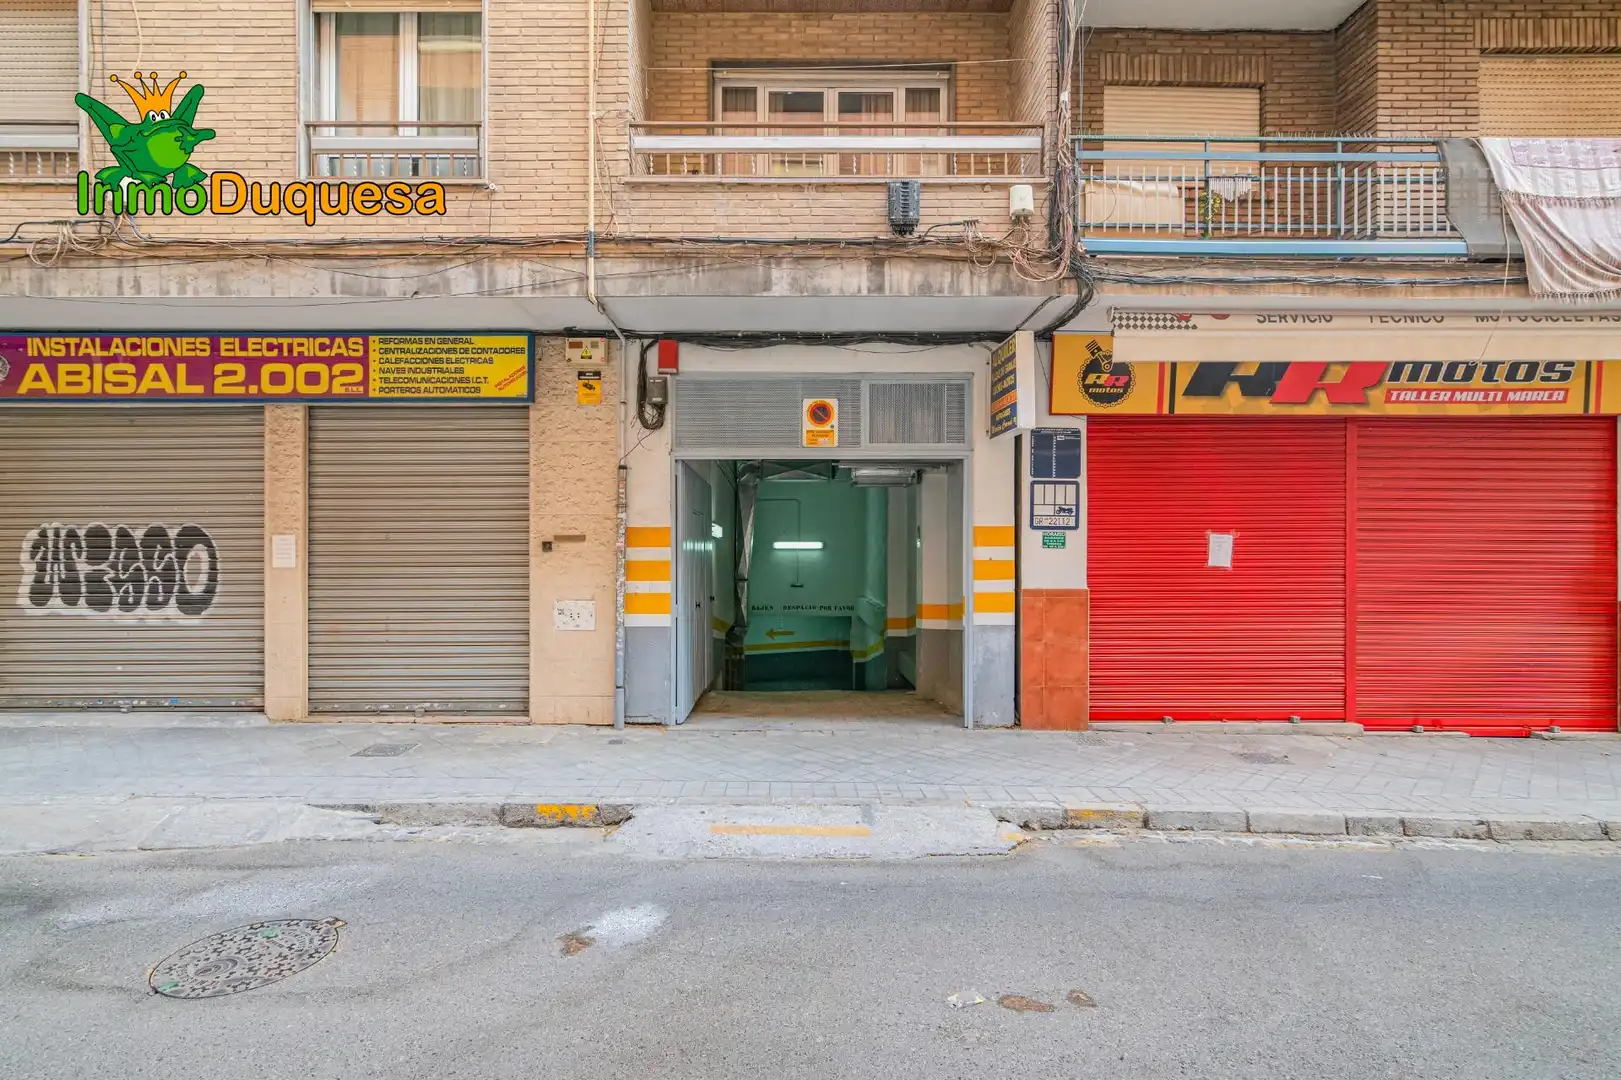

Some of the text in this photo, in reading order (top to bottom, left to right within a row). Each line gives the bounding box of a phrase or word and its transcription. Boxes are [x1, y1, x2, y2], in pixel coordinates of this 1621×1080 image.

[378, 337, 475, 345] REFORMAS EN GENERAL
[27, 337, 364, 357] INSTALACIONES ELECTRICAS
[378, 347, 526, 355] CENTRALIZACIONES DE CONTADORES
[16, 363, 364, 394] ABISAL 2.002
[378, 376, 471, 384] TELECOMUNICACIONES
[378, 386, 481, 394] PORTEROS AUTOMATICOS
[1390, 390, 1564, 402] TALLER MULTI MARCA
